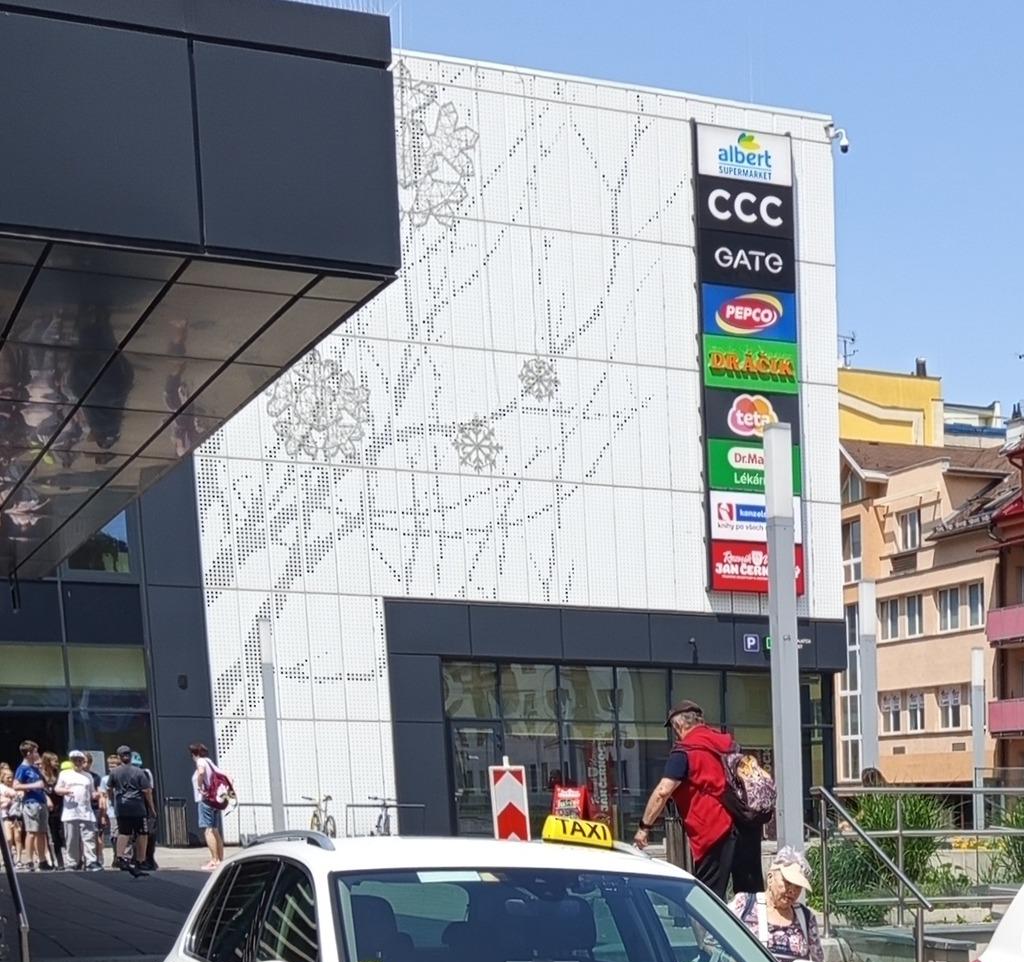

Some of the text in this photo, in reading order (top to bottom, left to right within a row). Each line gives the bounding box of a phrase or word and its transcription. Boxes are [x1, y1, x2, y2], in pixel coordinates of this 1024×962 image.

[718, 144, 772, 168] albert
[718, 166, 772, 181] SUPERMARKET
[707, 188, 784, 227] CCC
[725, 304, 774, 324] PEPCO
[734, 452, 765, 465] Dr.Ma
[733, 472, 765, 485] Lékár
[714, 562, 739, 575] JAN
[746, 636, 756, 649] P
[555, 817, 607, 840] TAXI
